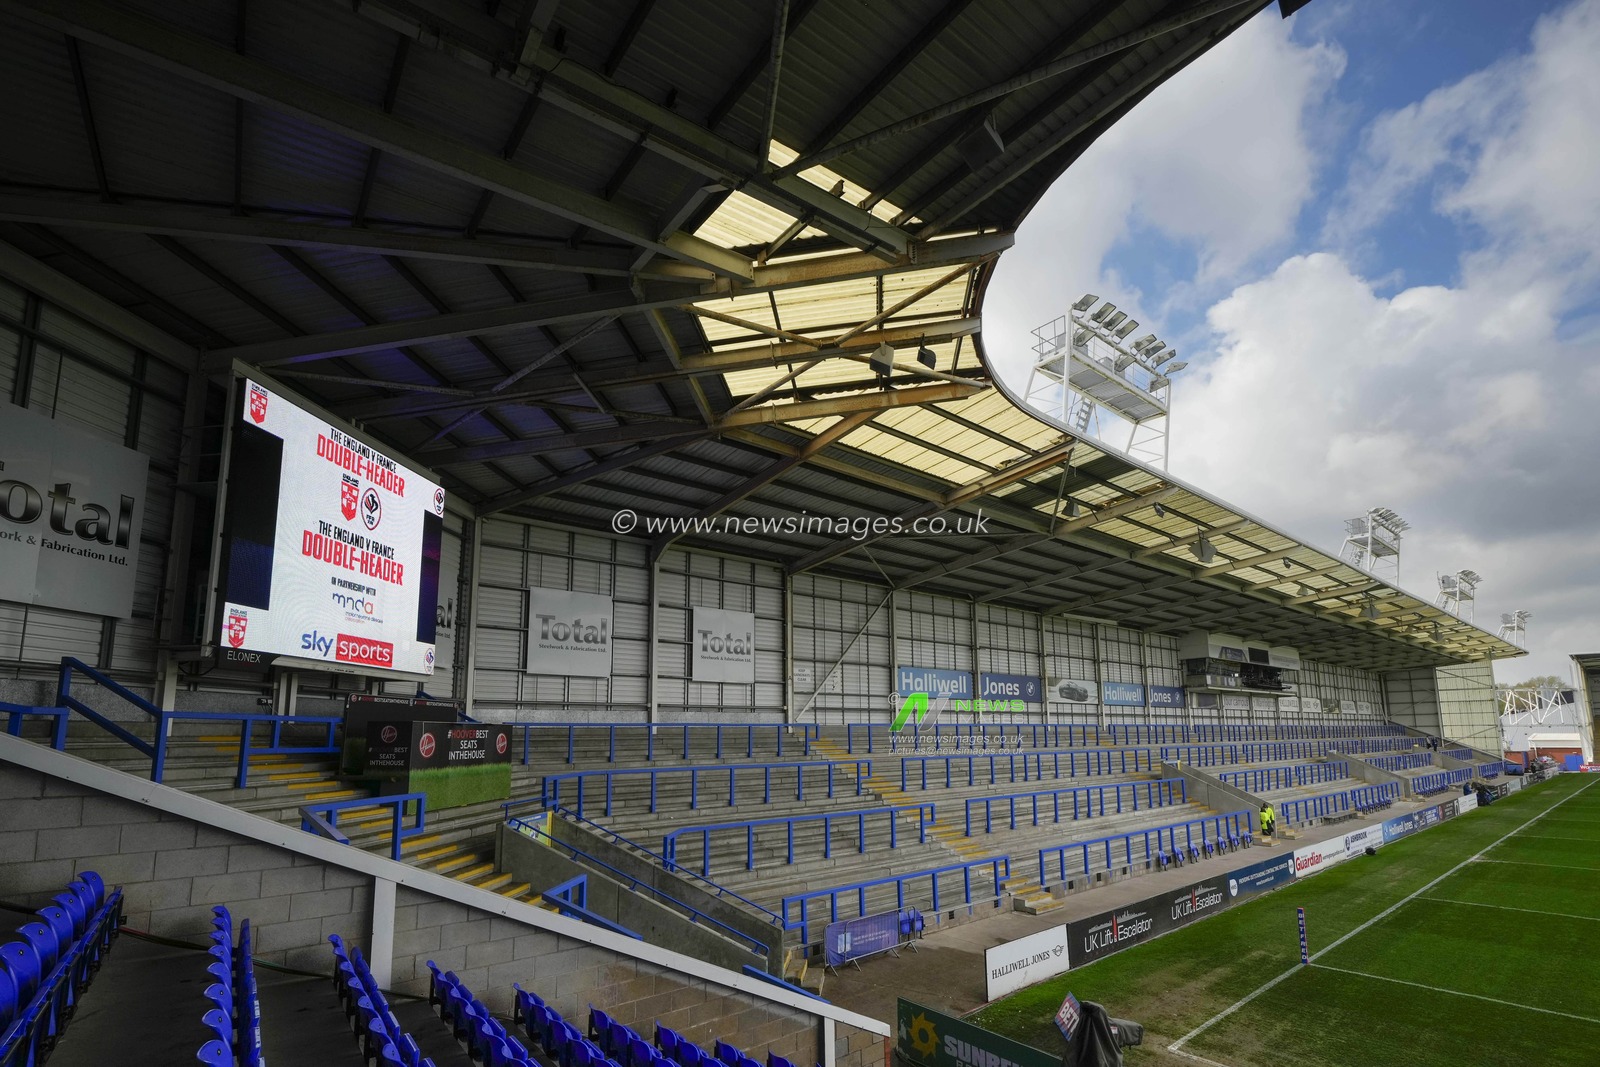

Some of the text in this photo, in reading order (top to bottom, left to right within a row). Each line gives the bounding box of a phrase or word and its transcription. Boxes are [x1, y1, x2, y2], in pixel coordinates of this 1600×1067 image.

[330, 428, 397, 473] THE ENGLAND V FRANCE
[317, 433, 405, 497] DOUBLE-HEADER
[0, 465, 135, 550] otal
[26, 535, 37, 545] &
[41, 538, 105, 561] Fabrication
[108, 554, 128, 566] Ltd.
[319, 520, 395, 560] THE ENGLAND V FRANCE
[302, 530, 404, 586] DOUBLE-HEADER
[536, 613, 608, 645] Total
[697, 629, 752, 656] Total
[226, 650, 262, 664] ELONEX
[301, 630, 334, 657] sky
[339, 640, 391, 662] sports
[538, 643, 564, 651] Steelwork
[570, 645, 598, 653] Fabrication
[901, 671, 1020, 696] Halliwell Jones
[1104, 685, 1172, 703] Halliwell Jones
[447, 729, 489, 739] #HOOVERBEST
[460, 740, 478, 749] SEATS
[448, 750, 485, 760] INTHEHOUSE
[1295, 851, 1323, 871] Guardian
[1171, 904, 1183, 920] UK
[1183, 901, 1193, 916] Lift
[1195, 892, 1223, 912] Escalator
[1084, 934, 1099, 953] UK
[1099, 927, 1114, 948] Lift
[1117, 918, 1153, 942] Escalator
[991, 950, 1051, 980] HALLIWELL JONES
